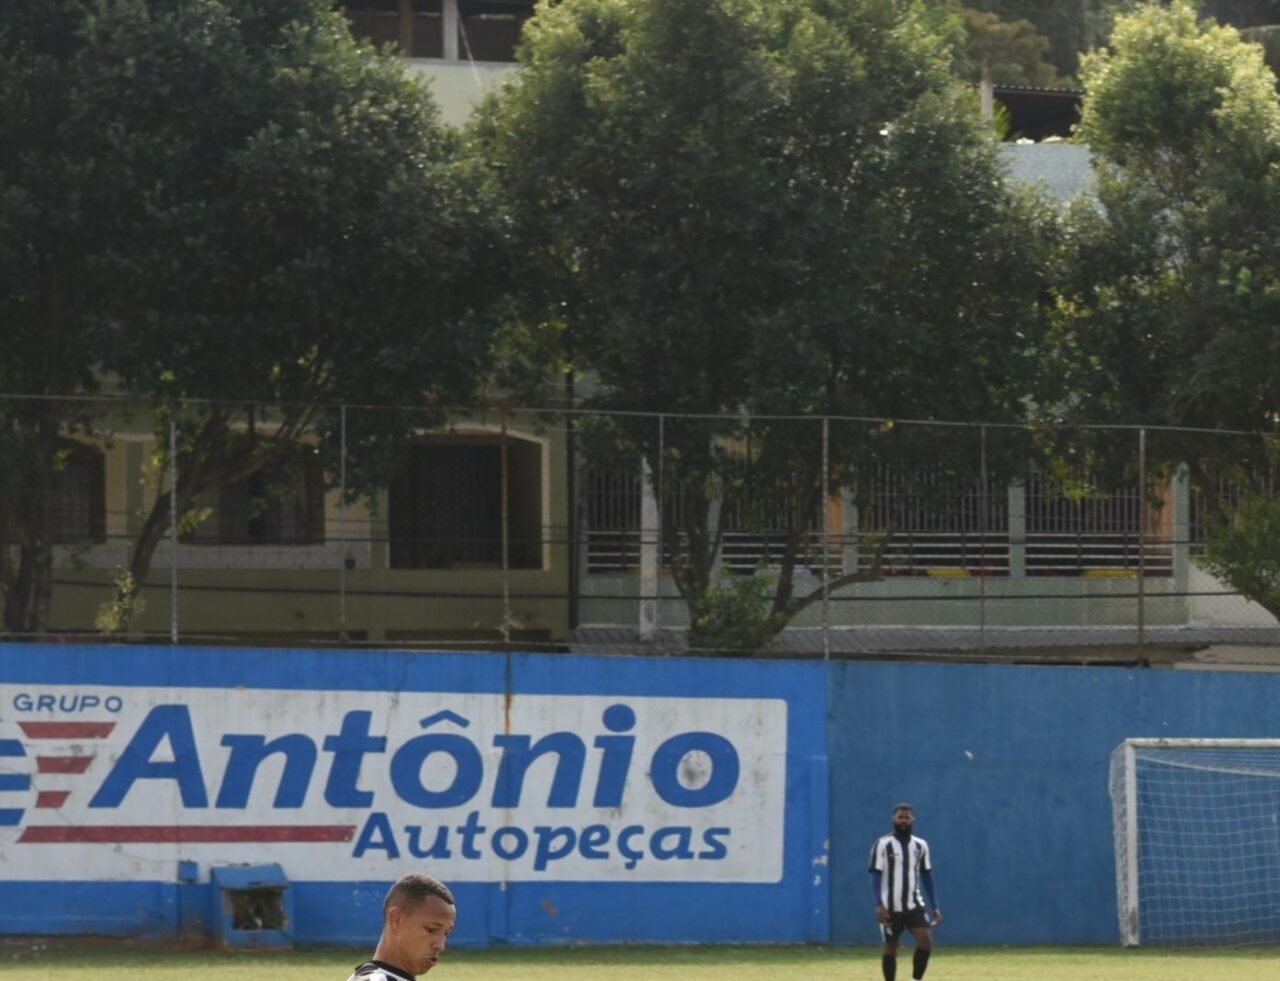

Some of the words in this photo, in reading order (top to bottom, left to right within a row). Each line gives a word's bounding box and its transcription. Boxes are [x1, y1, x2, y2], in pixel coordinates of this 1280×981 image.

[13, 693, 123, 712] GRUPO
[88, 704, 740, 809] Antônio
[352, 811, 731, 871] Autopeças
